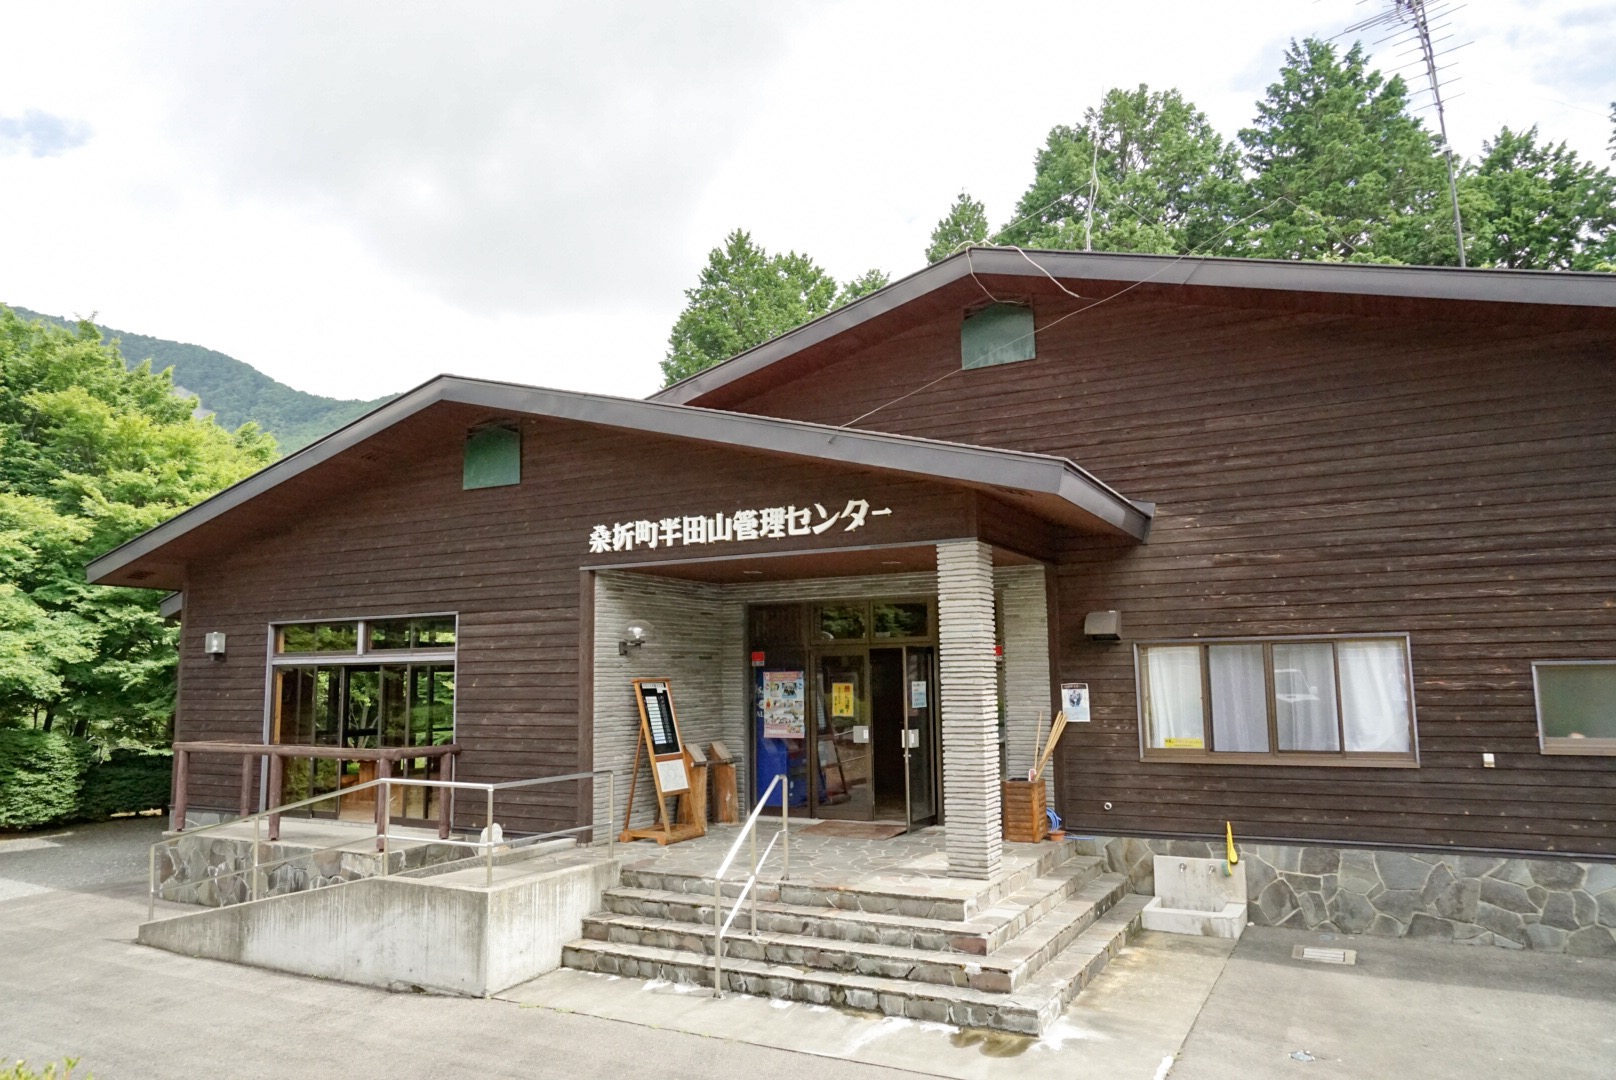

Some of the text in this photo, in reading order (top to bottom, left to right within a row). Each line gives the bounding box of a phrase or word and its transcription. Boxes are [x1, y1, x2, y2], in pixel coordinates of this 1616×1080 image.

[589, 499, 892, 553] 桑折町半田山管理センター
